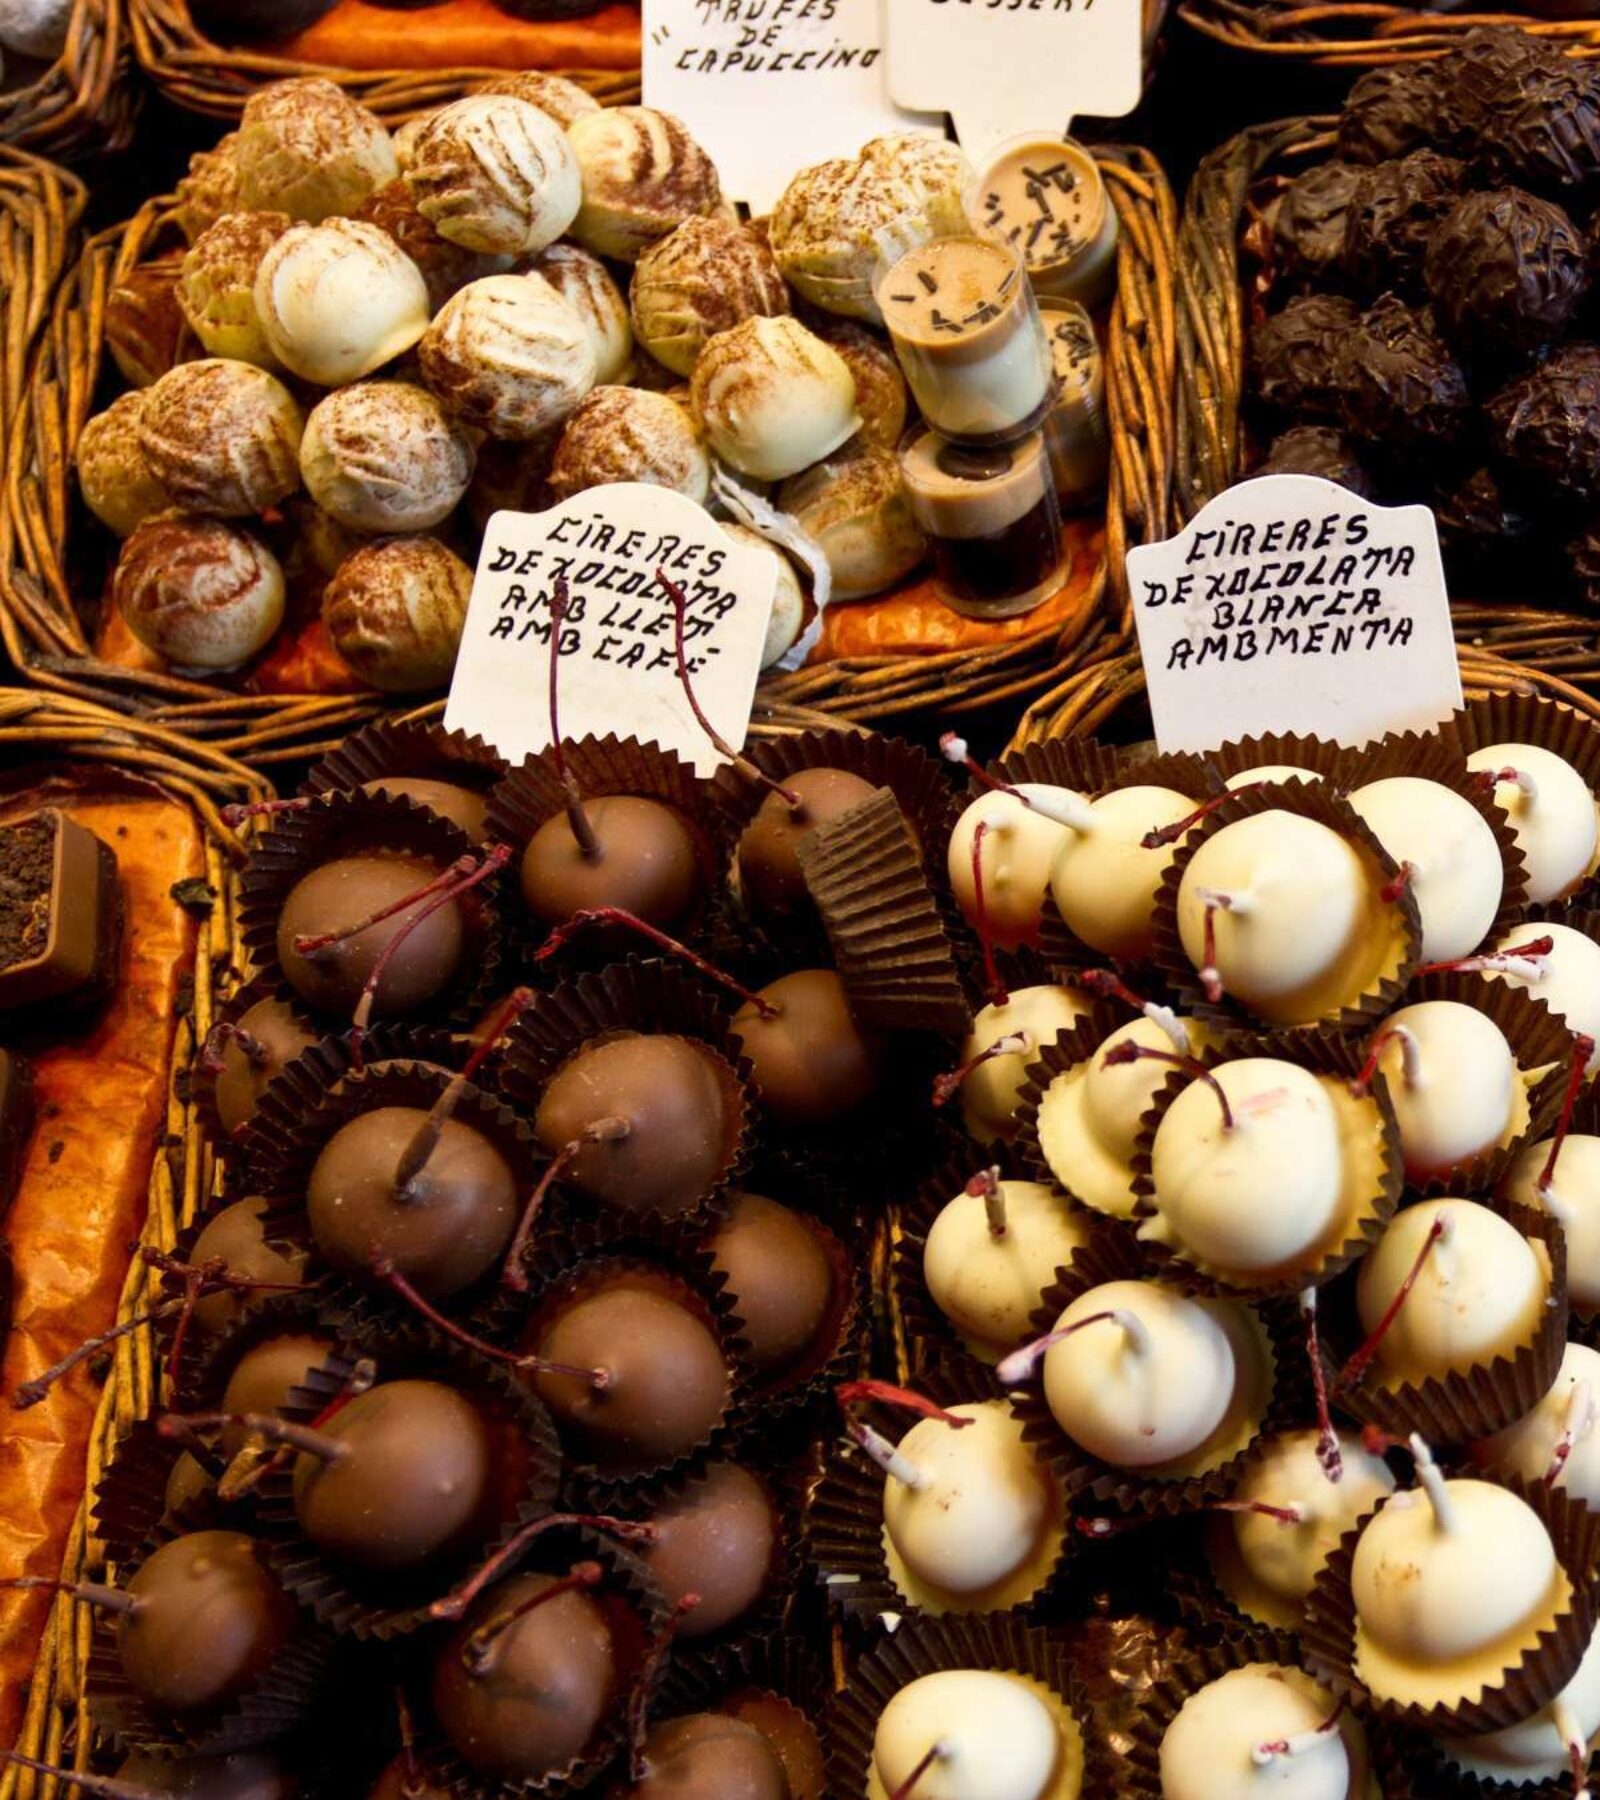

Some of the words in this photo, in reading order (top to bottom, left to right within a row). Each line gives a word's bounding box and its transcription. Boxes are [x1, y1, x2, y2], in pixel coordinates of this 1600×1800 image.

[735, 25, 782, 47] DE
[488, 546, 542, 574] DE
[548, 557, 737, 620] XOCOLATA
[1143, 574, 1194, 607] DE
[1205, 545, 1415, 600] XOCOLATA
[500, 584, 586, 622] AMB
[600, 602, 714, 641] LLET
[1212, 588, 1381, 629] BLANCA
[490, 616, 580, 656] AMB
